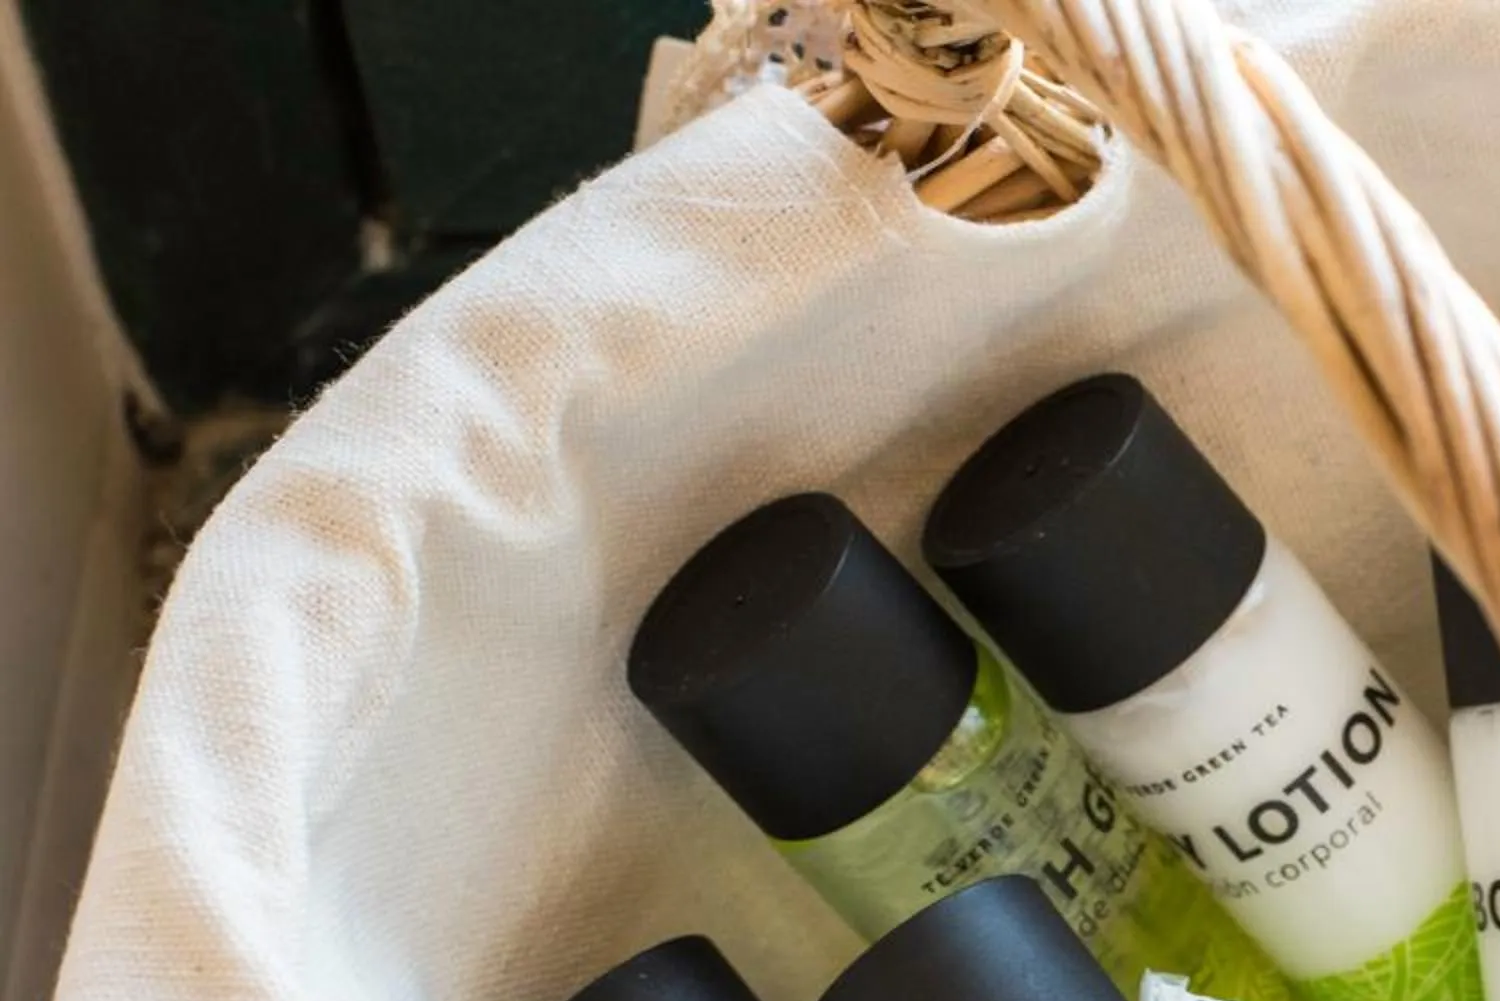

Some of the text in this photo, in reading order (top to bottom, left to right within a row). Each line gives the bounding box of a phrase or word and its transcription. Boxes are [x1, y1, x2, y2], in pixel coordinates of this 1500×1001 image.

[1182, 740, 1247, 783] GREEN
[1251, 704, 1288, 736] TEA
[1212, 667, 1400, 863] LOTION
[1265, 790, 1383, 888] corporal
[1078, 898, 1110, 937] de
